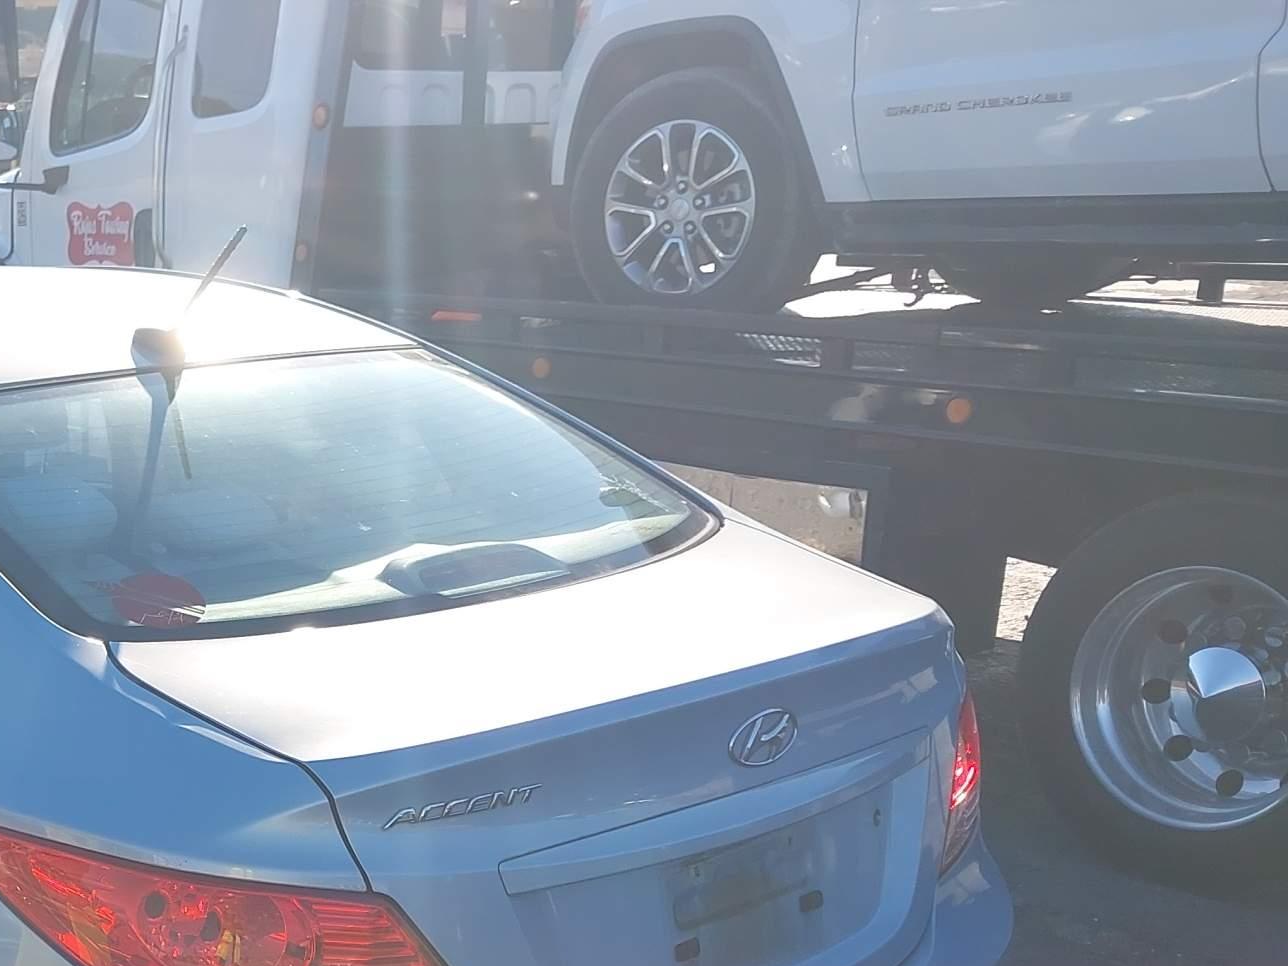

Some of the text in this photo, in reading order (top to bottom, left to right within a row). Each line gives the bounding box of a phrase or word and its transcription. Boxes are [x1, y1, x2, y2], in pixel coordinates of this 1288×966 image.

[884, 91, 1073, 117] GRAND CHEROKEE
[382, 783, 544, 831] ACCENT
